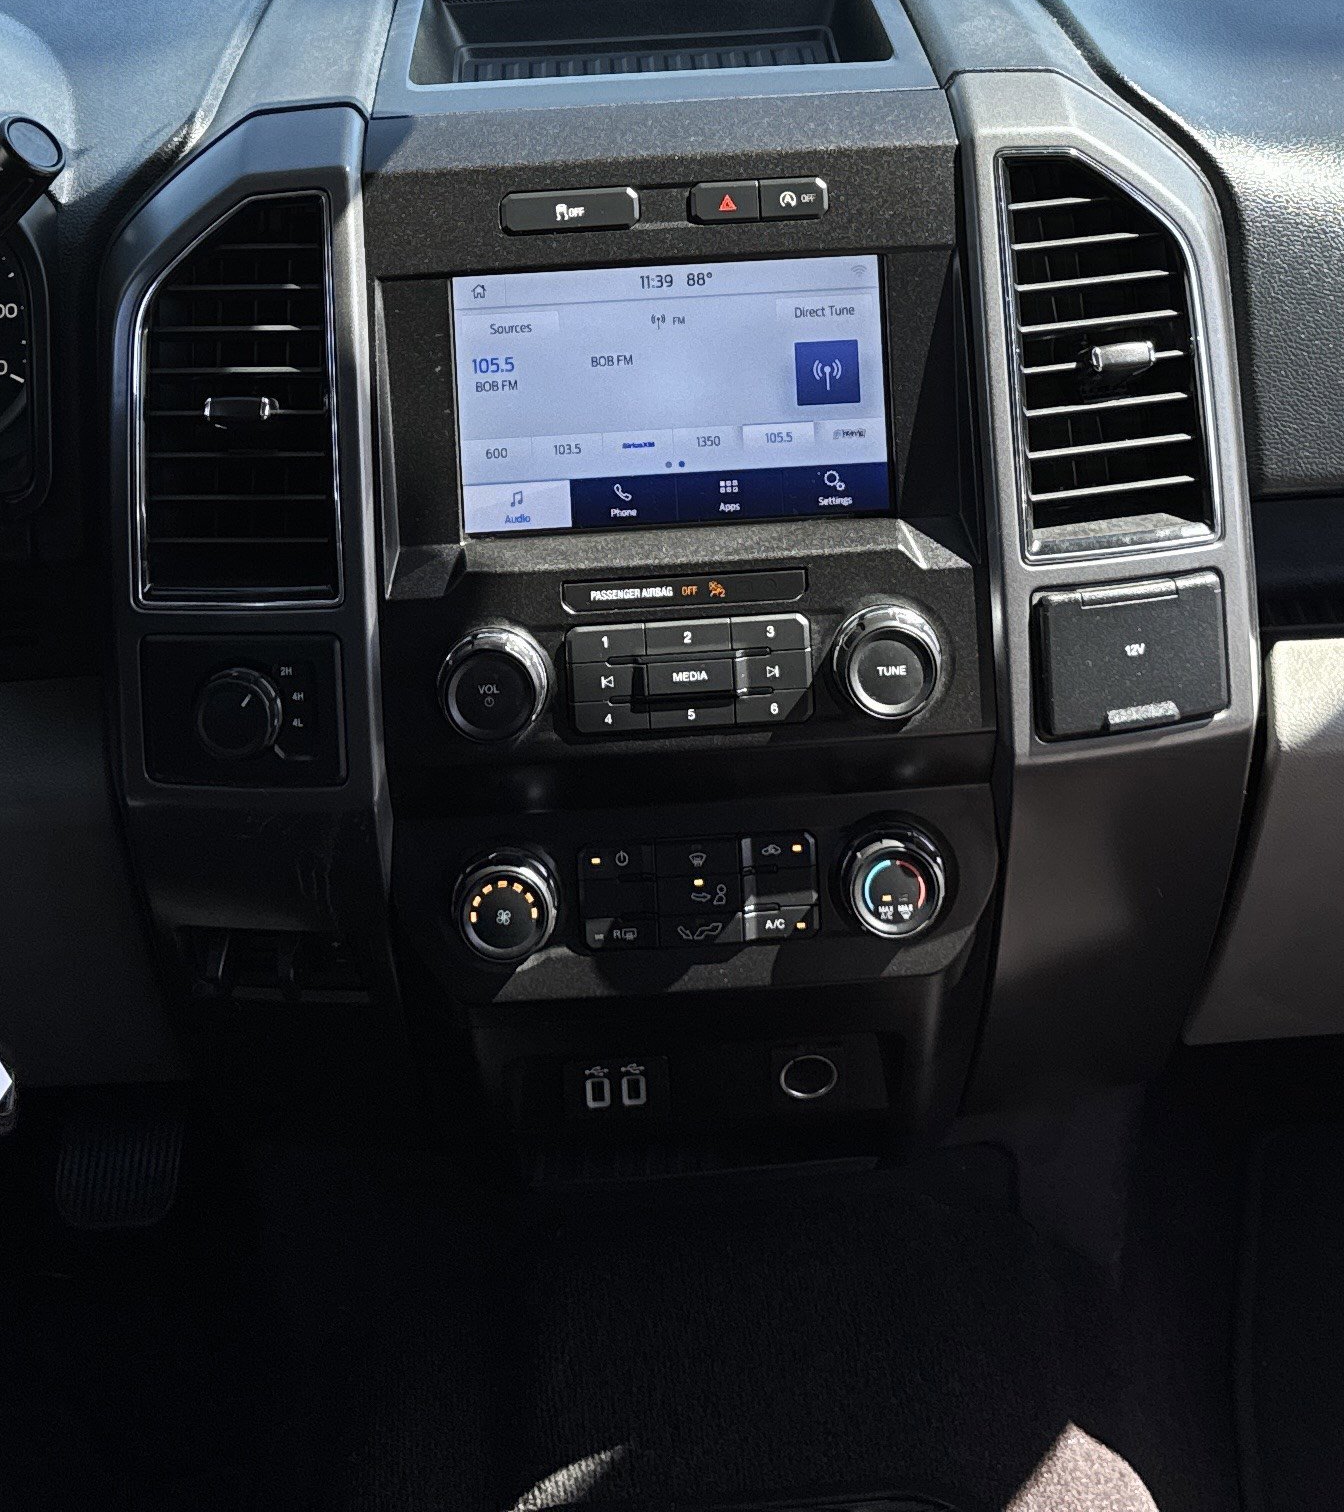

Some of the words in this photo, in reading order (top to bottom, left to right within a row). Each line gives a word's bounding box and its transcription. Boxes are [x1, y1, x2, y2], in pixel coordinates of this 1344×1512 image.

[800, 192, 817, 204] OFF
[567, 206, 585, 218] OFF
[639, 274, 674, 290] 11:39
[686, 271, 713, 287] 88°
[794, 306, 826, 319] Direct
[828, 304, 855, 317] Tune
[672, 315, 686, 326] FM
[489, 323, 532, 335] Sources
[472, 356, 516, 374] 105.5
[591, 356, 614, 368] BOB
[616, 354, 634, 366] FM
[475, 381, 499, 393] BOB
[501, 379, 518, 391] FM
[696, 435, 721, 448] 1350
[764, 431, 793, 444] 105.5
[485, 447, 508, 460] 600
[553, 443, 582, 456] 103.5
[818, 495, 853, 507] Settings
[610, 508, 638, 518] Phone
[718, 502, 741, 513] Apps
[504, 514, 531, 524] Audio
[590, 588, 641, 601] PASSENGER
[641, 585, 674, 598] AIRBAG
[681, 585, 698, 596] OFF
[683, 631, 692, 643] 2
[766, 625, 775, 638] 3
[601, 635, 609, 648] 1
[1124, 642, 1146, 657] 12V
[280, 666, 293, 676] 2H
[672, 670, 709, 682] MEDIA
[876, 665, 907, 677] TUNE
[477, 683, 500, 695] VOL
[292, 691, 305, 701] 4H
[687, 708, 696, 720] 5
[770, 703, 779, 714] 6
[292, 717, 304, 728] 4L
[604, 713, 613, 725] 4
[765, 918, 786, 930] A/C
